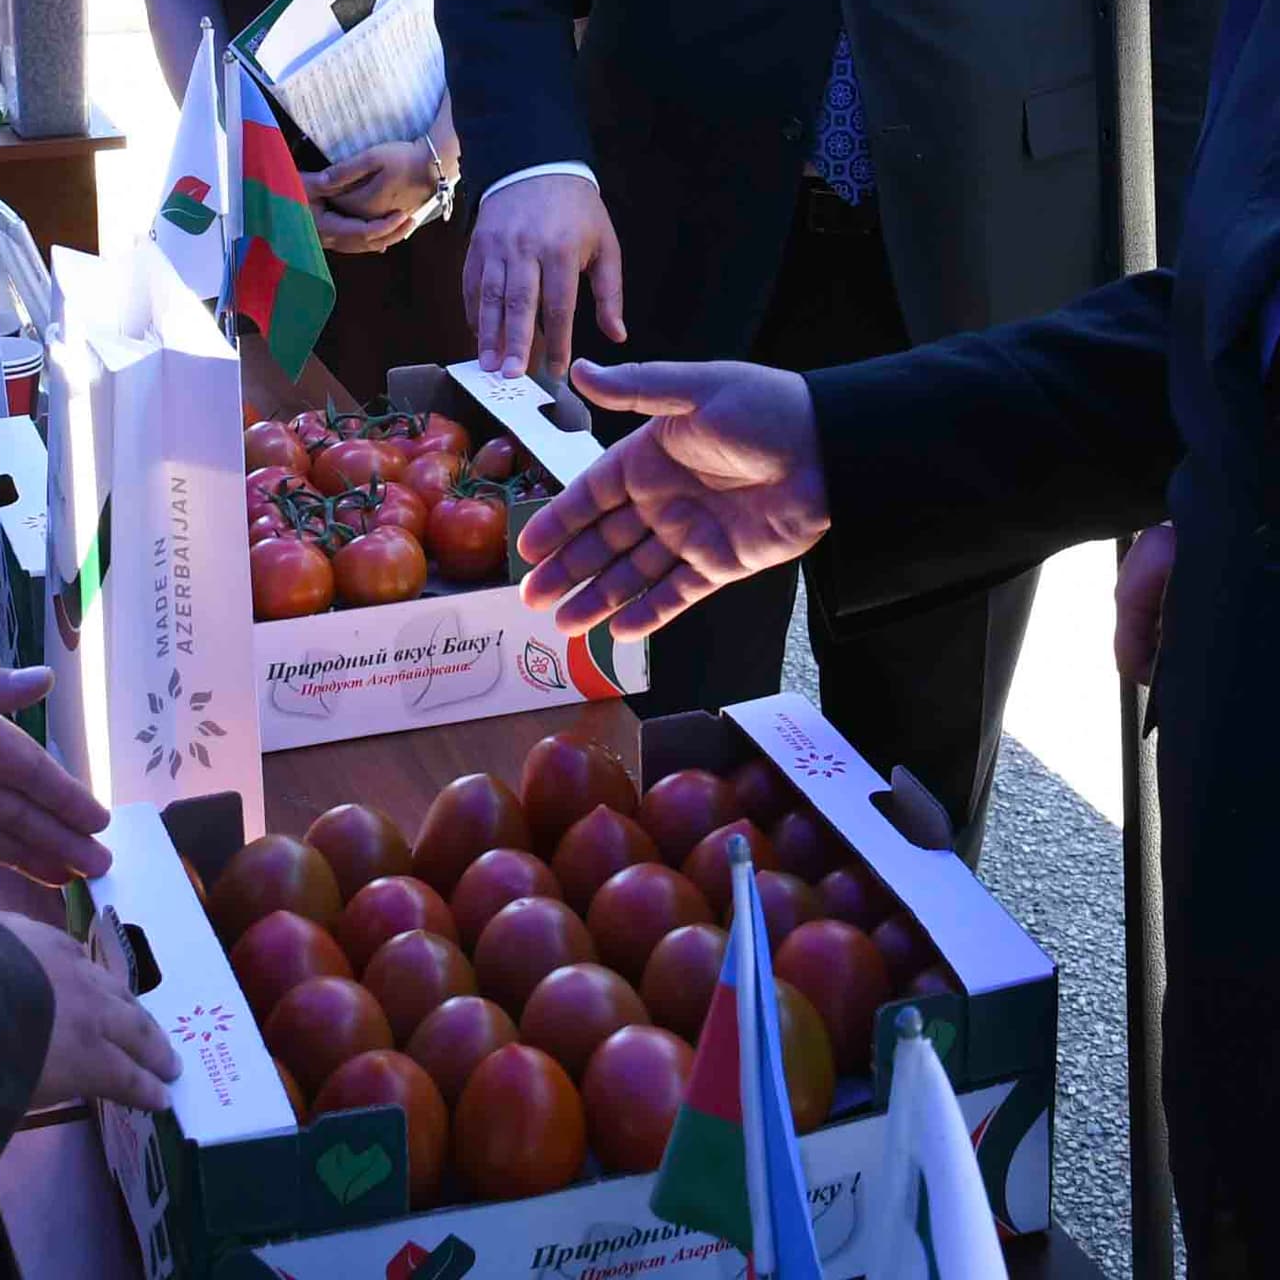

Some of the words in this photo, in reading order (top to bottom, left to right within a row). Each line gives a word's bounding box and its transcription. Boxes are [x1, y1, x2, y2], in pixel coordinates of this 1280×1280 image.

[153, 536, 167, 567] IN
[171, 477, 194, 656] AZERBAIJAN
[154, 574, 170, 659] MADE
[266, 648, 388, 682] Природный
[393, 644, 438, 664] вкус
[442, 636, 491, 656] Баку
[496, 629, 504, 646] !
[300, 679, 364, 697] Продукт
[807, 1183, 842, 1206] ку
